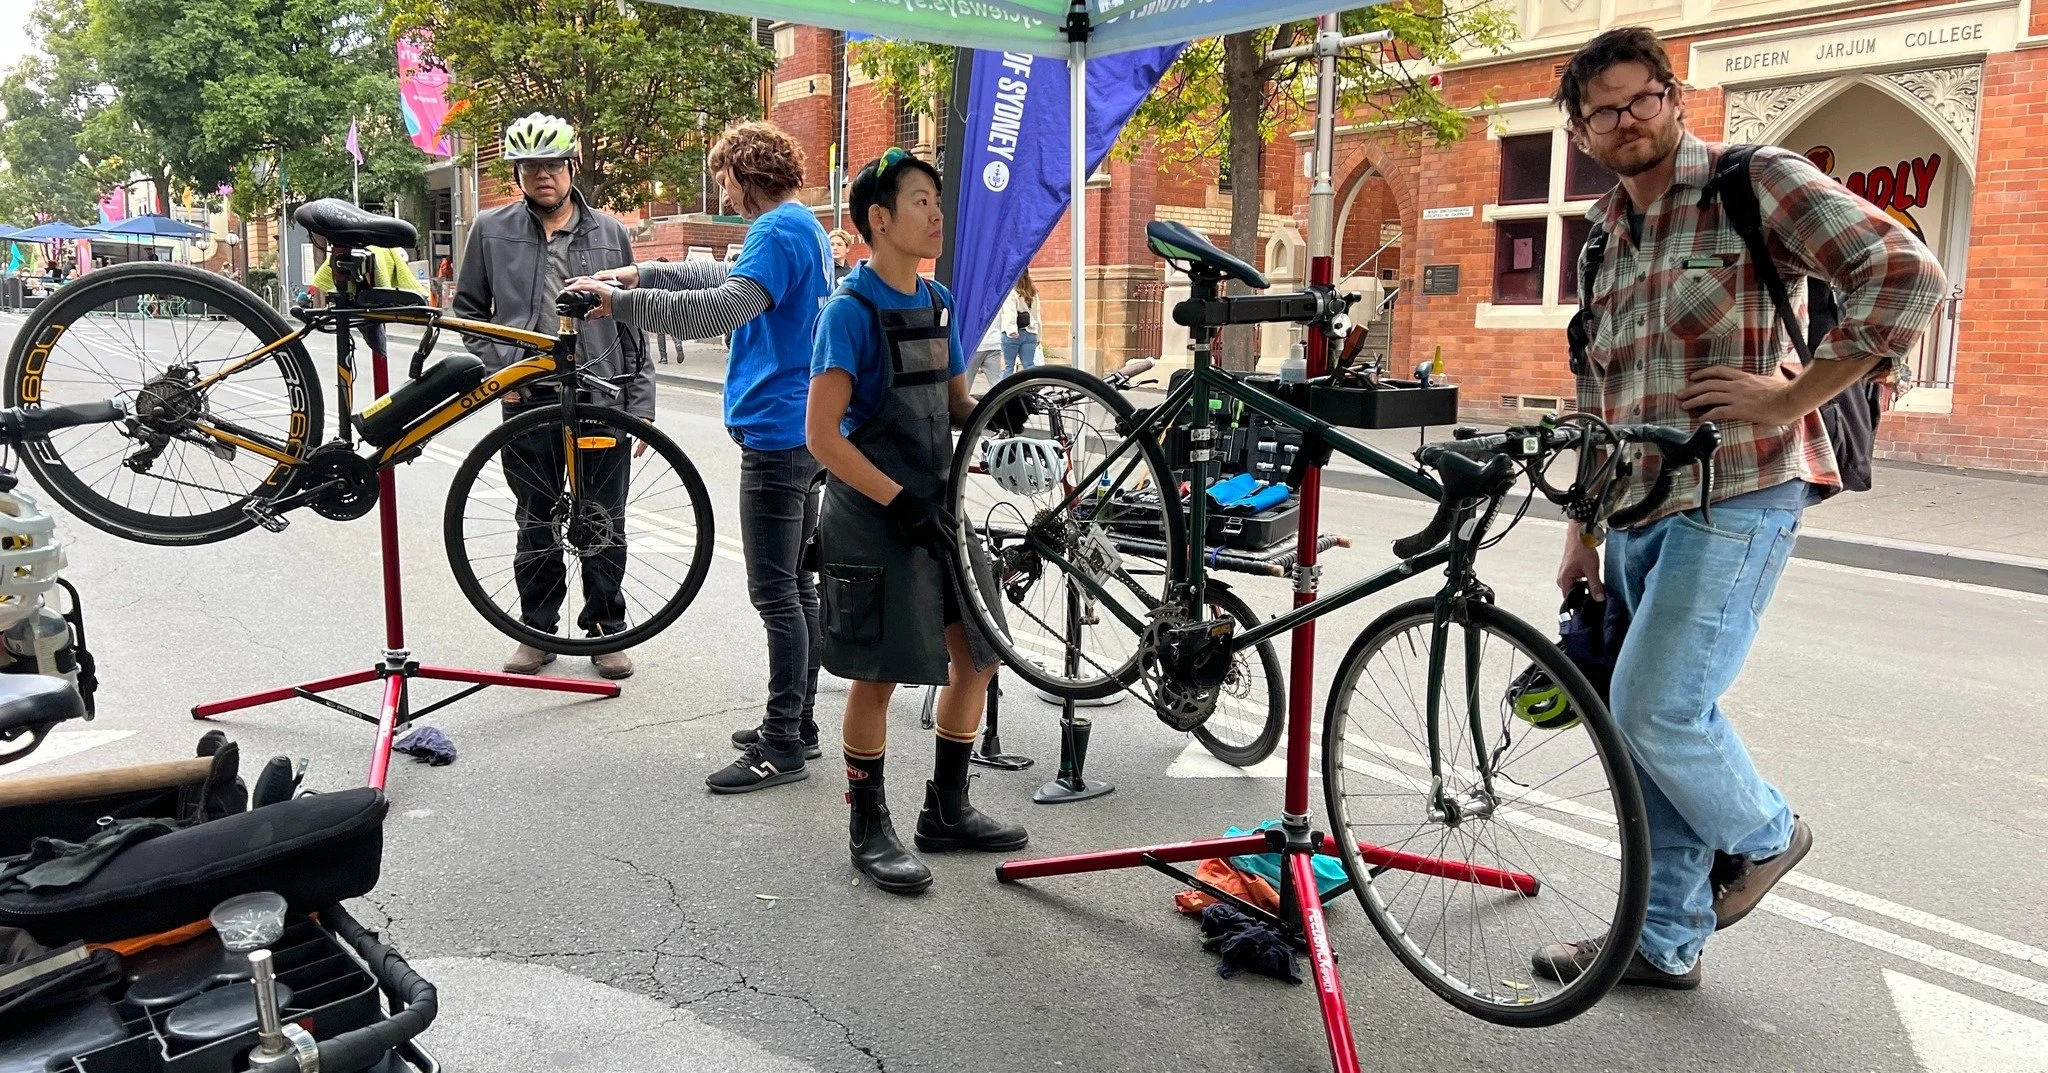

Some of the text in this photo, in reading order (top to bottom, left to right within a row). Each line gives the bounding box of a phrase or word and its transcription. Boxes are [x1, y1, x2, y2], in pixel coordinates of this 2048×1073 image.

[1725, 24, 1983, 72] REDFERN JARJUM COLLEGE
[986, 77, 1028, 161] SYDNEY
[1844, 153, 1942, 213] ADLY
[460, 380, 500, 409] otto
[1307, 907, 1334, 970] FEEDBACK
